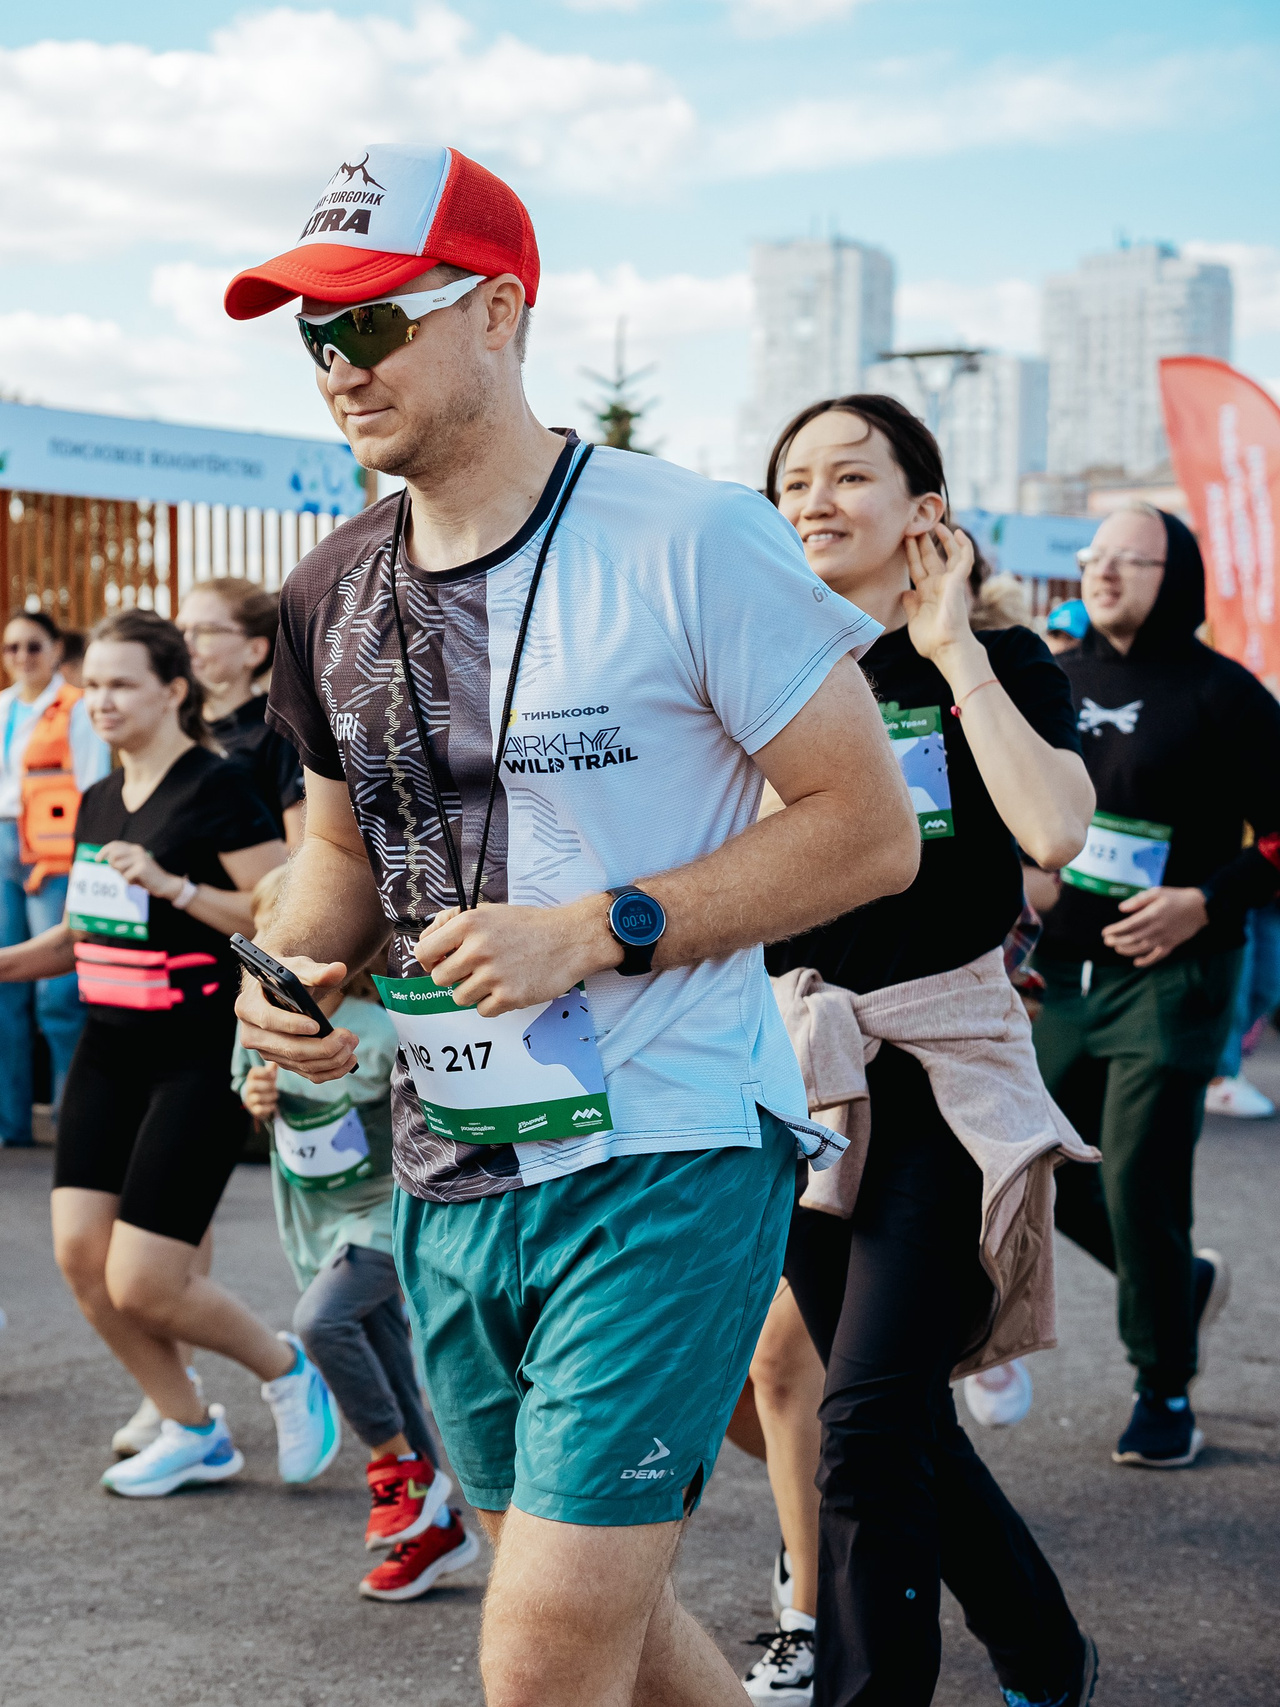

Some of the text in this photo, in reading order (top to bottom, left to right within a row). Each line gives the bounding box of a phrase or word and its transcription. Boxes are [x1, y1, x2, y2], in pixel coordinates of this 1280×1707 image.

[521, 705, 610, 721] ТИНЬКОФФ
[503, 726, 623, 758] ARKHYZ
[503, 747, 639, 774] WILD TRAIL
[622, 913, 652, 928] 16:00
[390, 990, 408, 1001] Забег
[441, 1041, 493, 1073] 217
